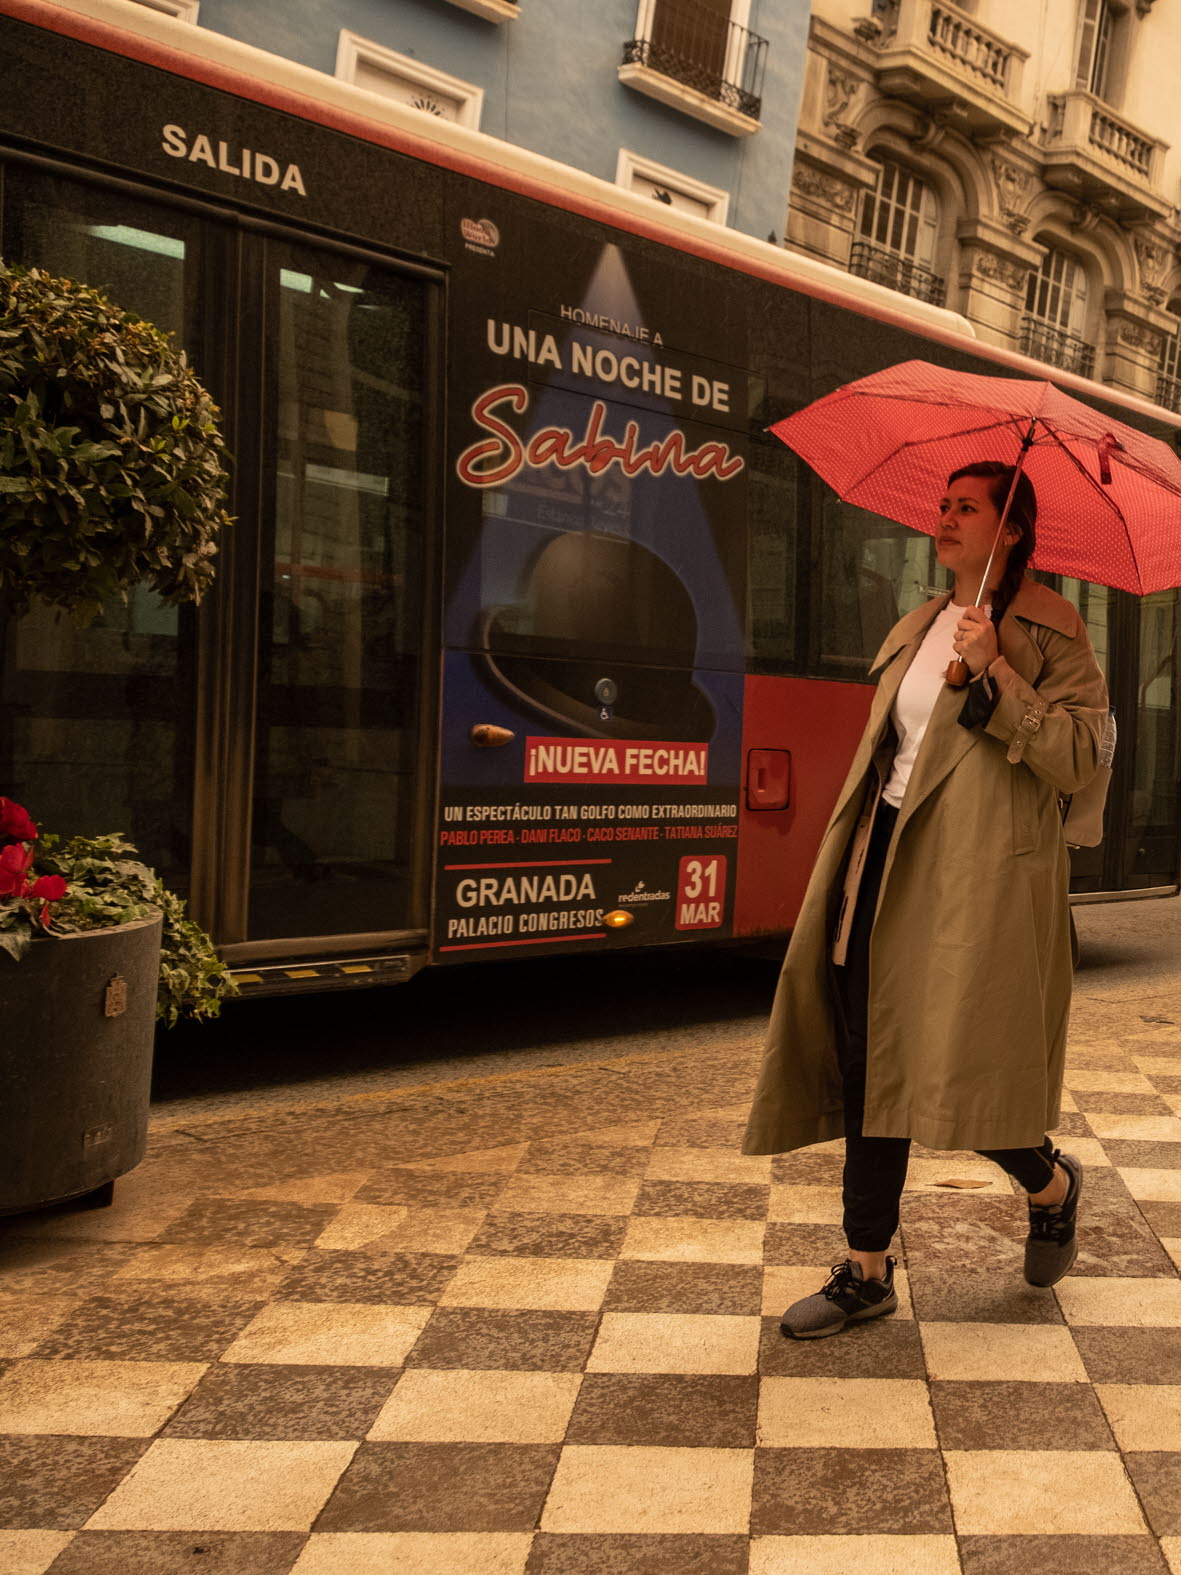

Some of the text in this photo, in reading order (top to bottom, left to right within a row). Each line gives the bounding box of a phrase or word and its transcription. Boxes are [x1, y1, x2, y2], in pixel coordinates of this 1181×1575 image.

[162, 124, 306, 196] SALIDA
[560, 304, 663, 346] HOMENAJE A
[487, 319, 730, 412] UNA NOCHE DE
[457, 384, 745, 488] Sabina
[529, 745, 706, 776] ¡NUEVA FECHA!
[444, 803, 737, 821] UN ESPECTÁCULO TAN GOLFO COMO EXTRAORDINARIO
[440, 822, 738, 846] PABLO PEREA DANI FLACO CACO SENANTE TATIANA SUÁREZ
[456, 873, 596, 908] GRANADA
[618, 890, 670, 902] redentradas
[684, 860, 718, 899] 31
[448, 909, 604, 939] PALACIO CONGRESOS
[680, 902, 720, 925] MAR
